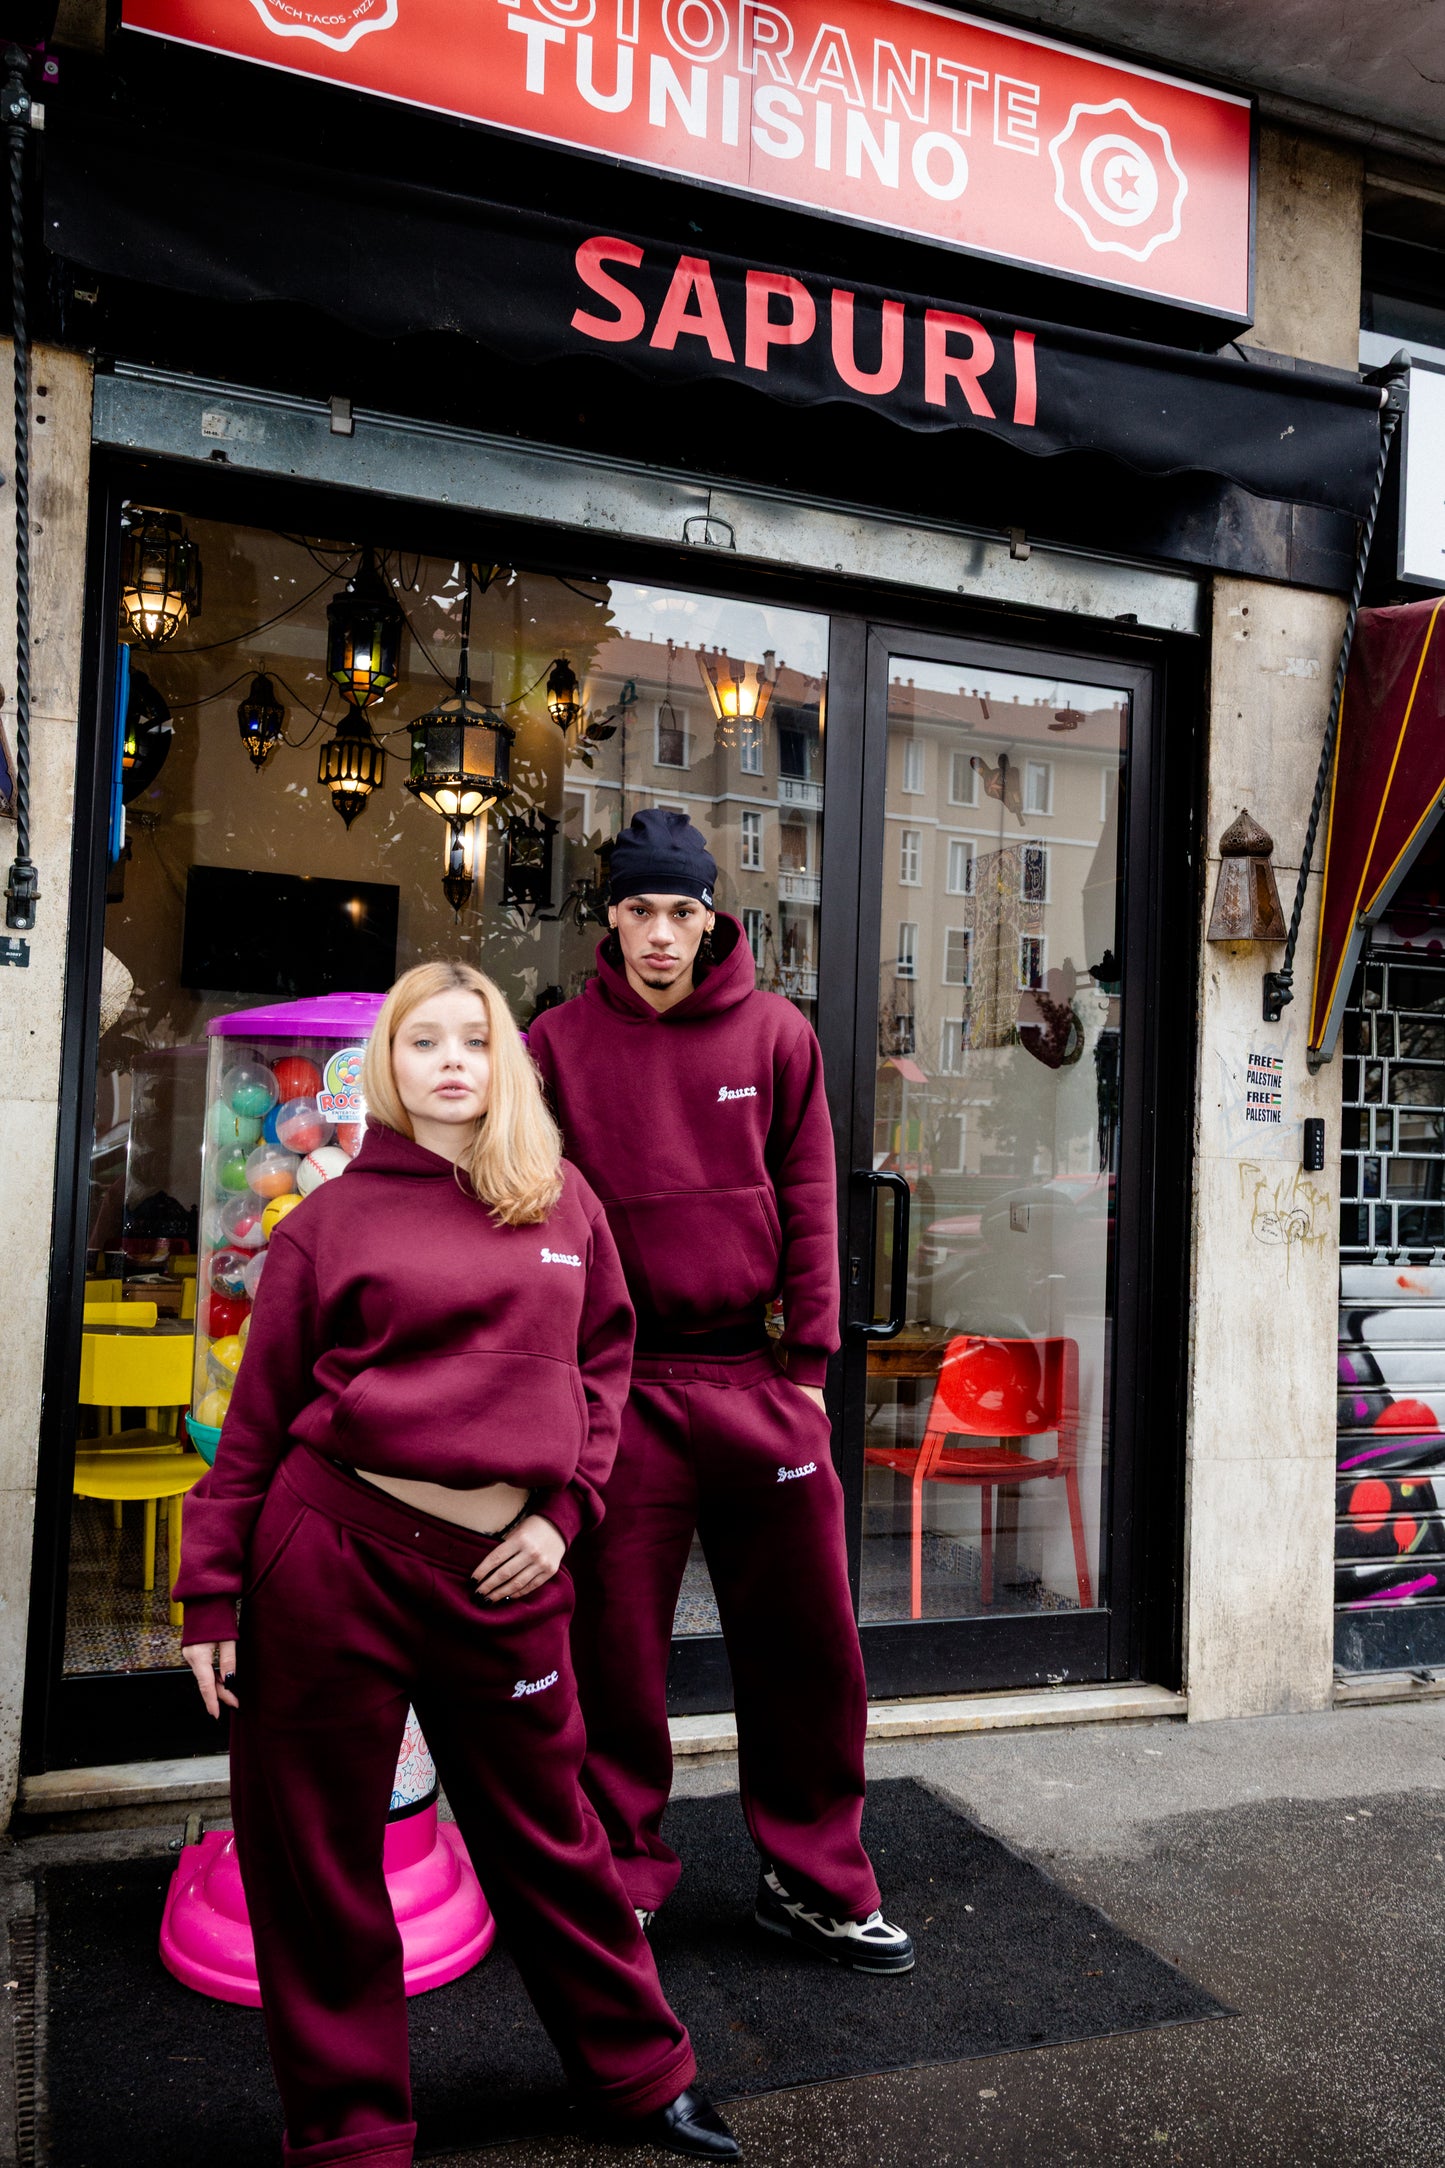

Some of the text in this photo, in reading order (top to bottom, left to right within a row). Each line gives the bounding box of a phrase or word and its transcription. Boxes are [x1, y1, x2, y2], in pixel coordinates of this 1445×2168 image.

[305, 13, 346, 25] TACOS
[498, 0, 1040, 156] TORANTE
[508, 13, 969, 201] TUNISINO
[571, 236, 1037, 426] SAPURI
[1248, 1053, 1272, 1068] FREE
[1246, 1070, 1282, 1088] PALESTINE
[1247, 1091, 1271, 1104] FREE
[1245, 1107, 1281, 1123] PALESTINE
[776, 1461, 818, 1483] Sauce
[511, 1670, 559, 1698] Sauce
